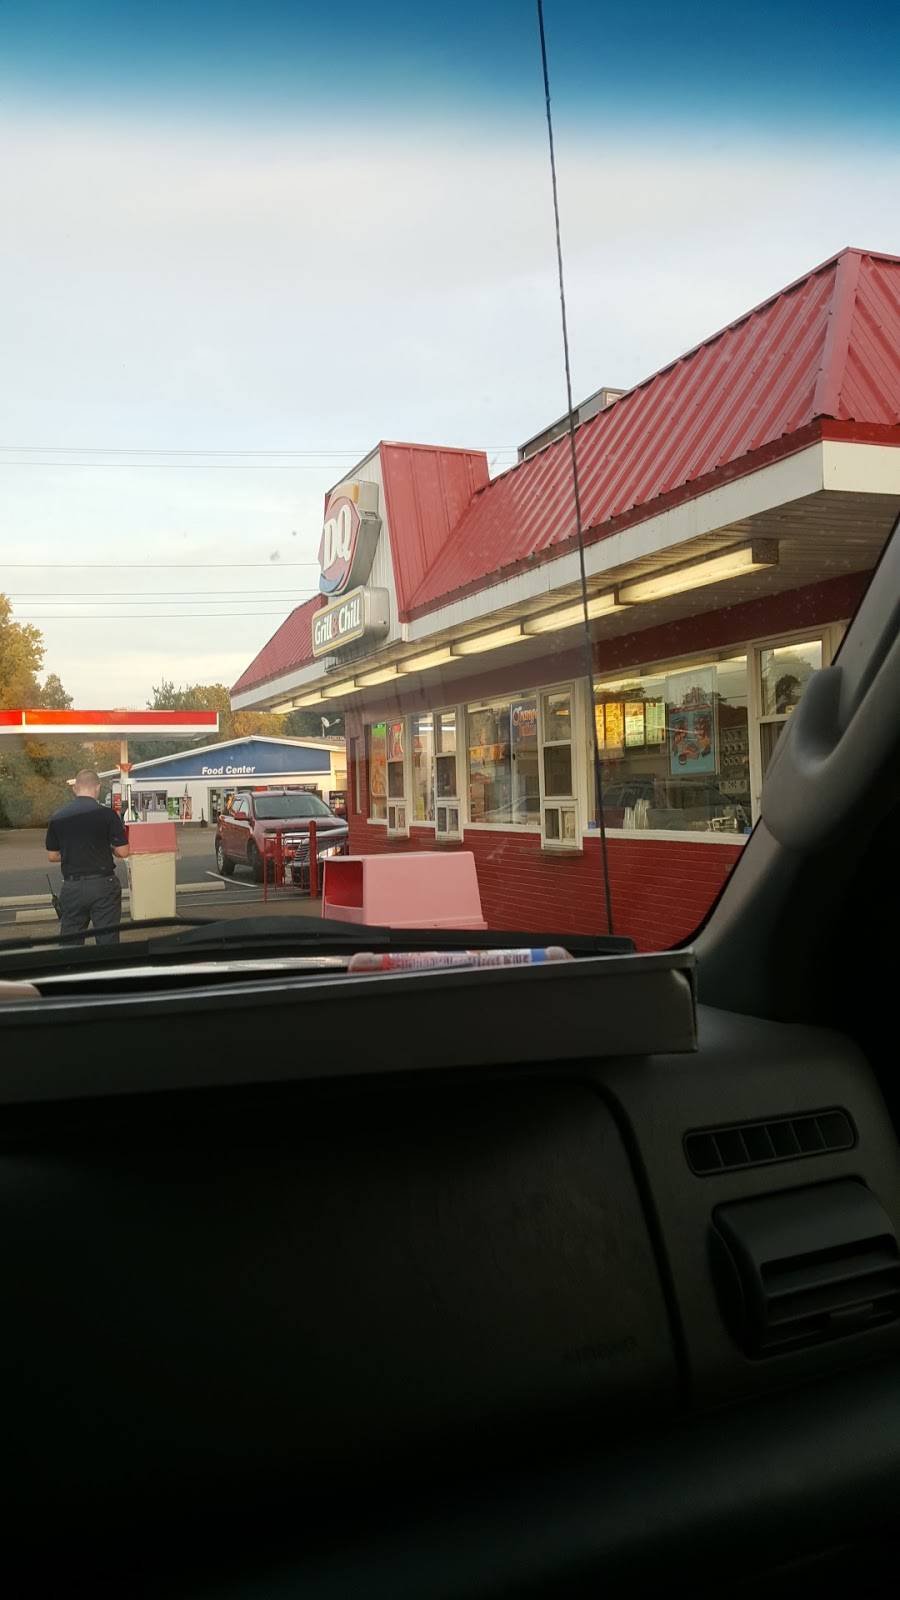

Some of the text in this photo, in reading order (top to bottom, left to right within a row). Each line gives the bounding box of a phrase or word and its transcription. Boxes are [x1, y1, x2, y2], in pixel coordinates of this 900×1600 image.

[323, 504, 352, 571] DQ
[315, 599, 360, 645] Grill & Chill
[202, 765, 255, 775] Food Center
